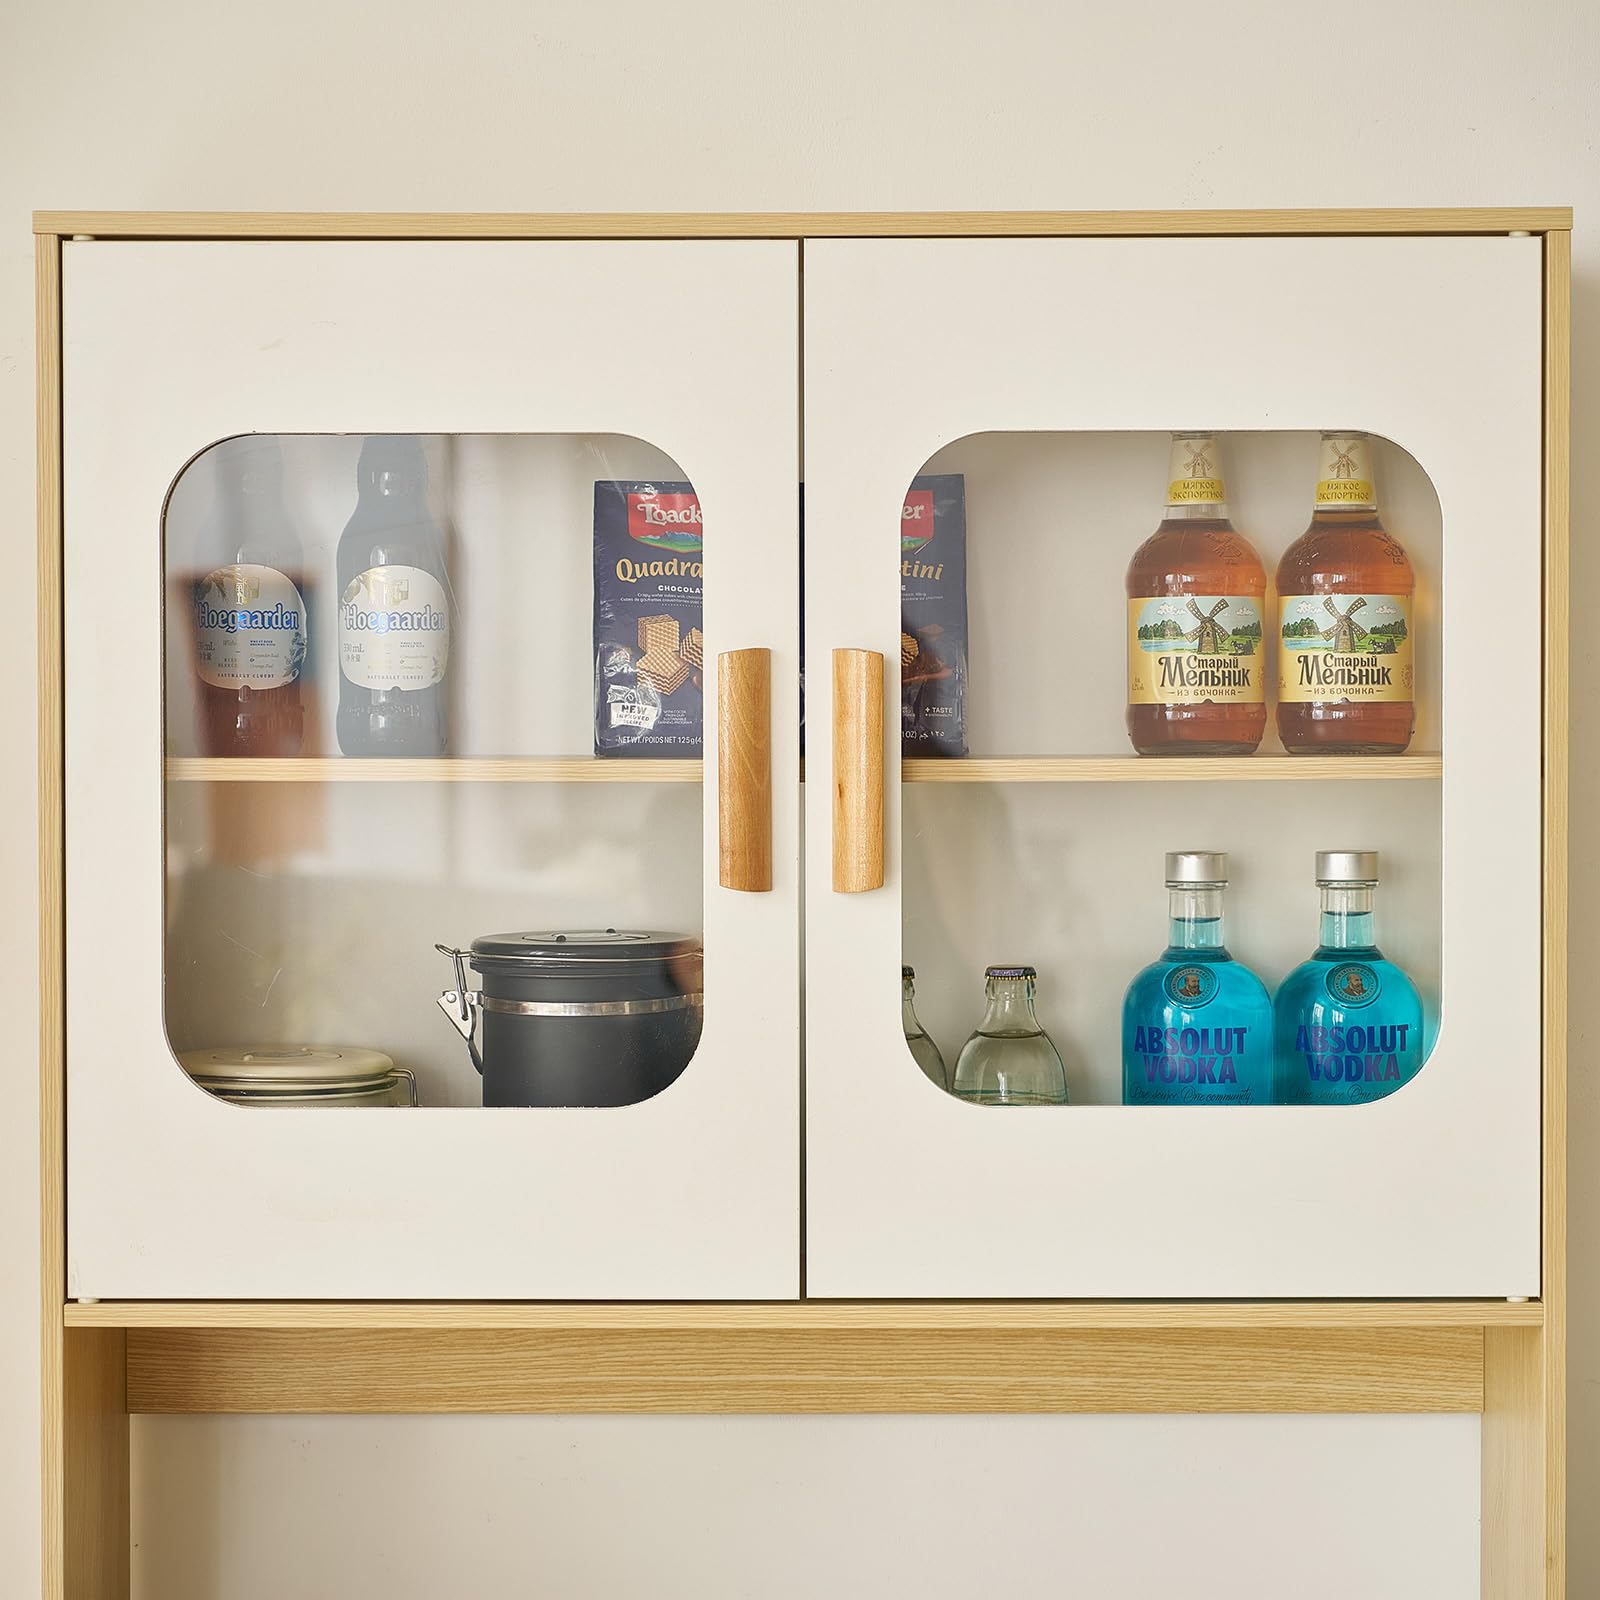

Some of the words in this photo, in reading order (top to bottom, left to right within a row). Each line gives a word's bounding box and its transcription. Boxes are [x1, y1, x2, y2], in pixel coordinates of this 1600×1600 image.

[637, 504, 703, 526] Toack
[903, 504, 925, 519] er
[616, 558, 703, 583] Quadra
[198, 602, 299, 633] Hoegaarden
[345, 603, 445, 634] Hoegaarden
[1158, 656, 1250, 687] Мельник
[1186, 655, 1239, 672] Старый
[1297, 655, 1393, 685] Мельник
[1323, 653, 1378, 670] Старый
[664, 736, 676, 744] NET
[1134, 1025, 1247, 1056] ABSOLUT
[1296, 1024, 1408, 1054] ABSOLUT
[1143, 1055, 1238, 1084] VODKA
[1306, 1053, 1400, 1082] VODKA
[1181, 1085, 1204, 1103] One
